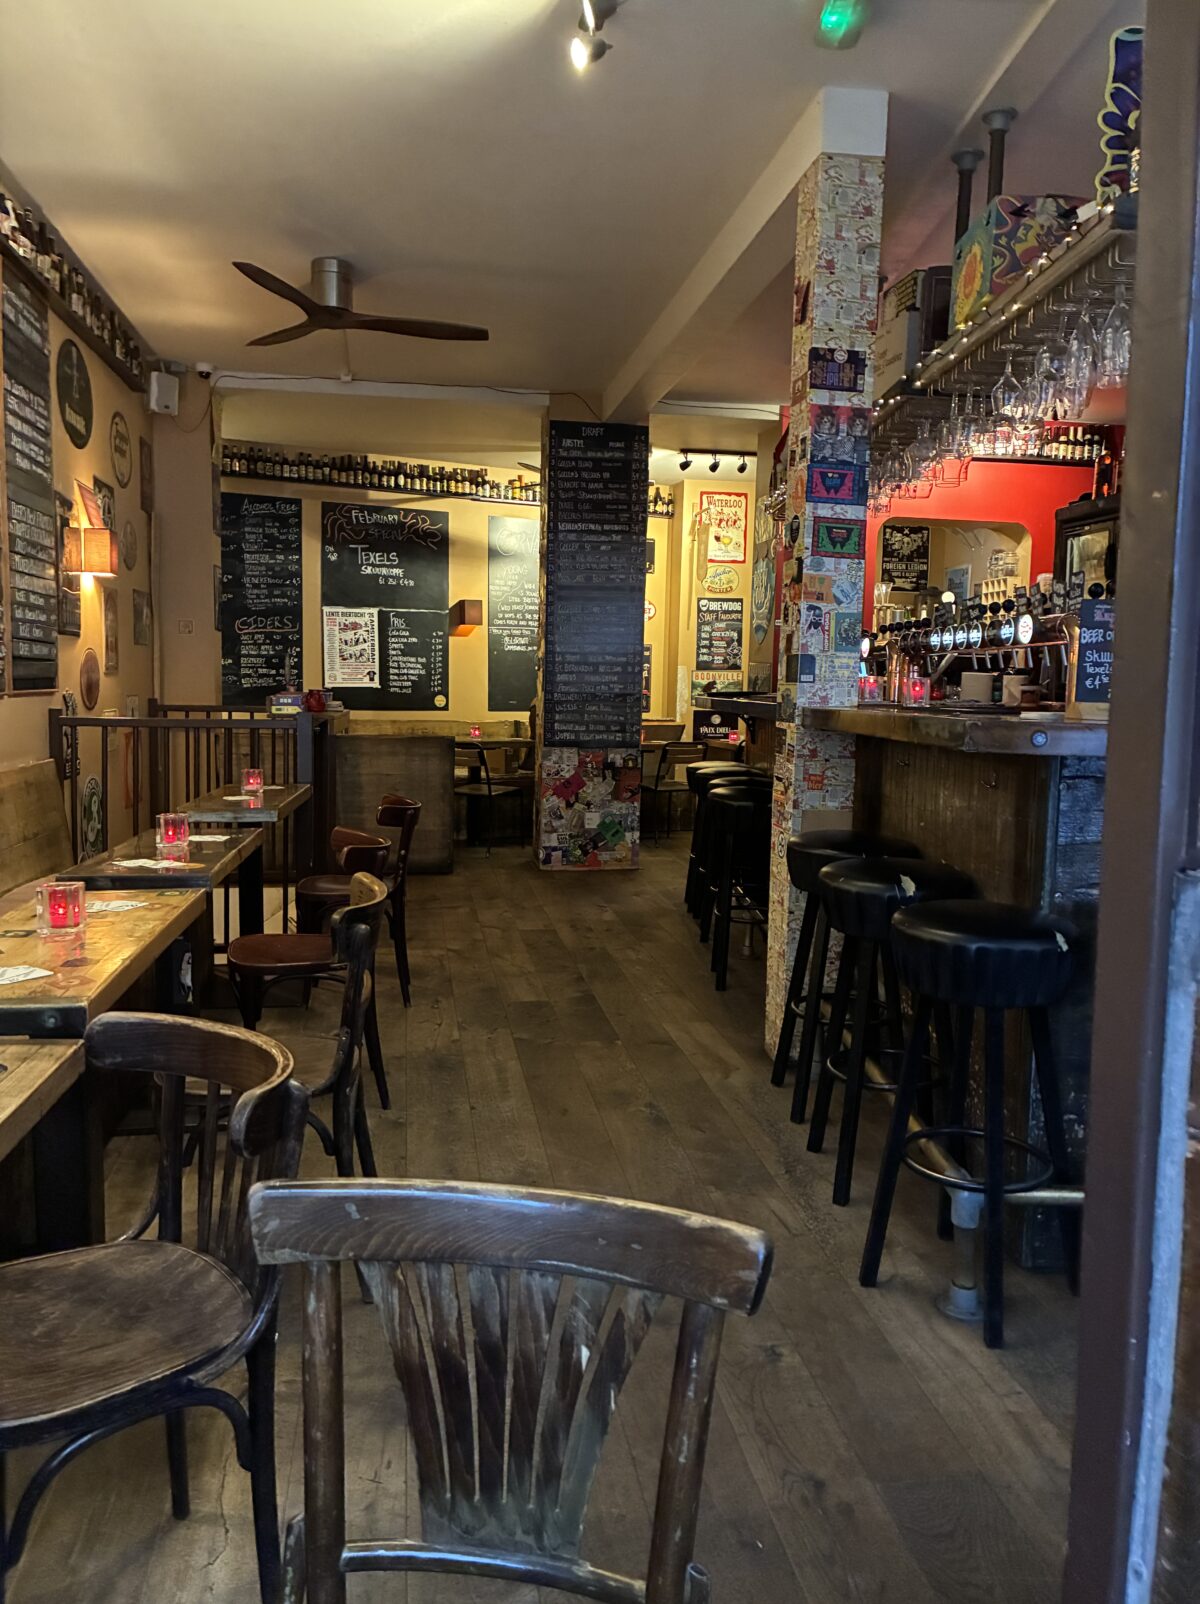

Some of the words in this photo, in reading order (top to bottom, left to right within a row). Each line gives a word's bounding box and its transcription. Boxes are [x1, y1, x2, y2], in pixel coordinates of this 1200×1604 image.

[706, 496, 743, 508] WATERLOO
[349, 544, 399, 565] TEXELS
[908, 563, 928, 571] LEGION
[709, 601, 742, 610] BREWDOG
[239, 616, 293, 629] CIDERS
[390, 611, 406, 628] FRIS
[698, 612, 717, 622] STAFF
[823, 630, 831, 651] HOPPY
[1081, 628, 1104, 644] BEER
[694, 672, 740, 681] BOONVILLE
[700, 726, 716, 734] PAIX
